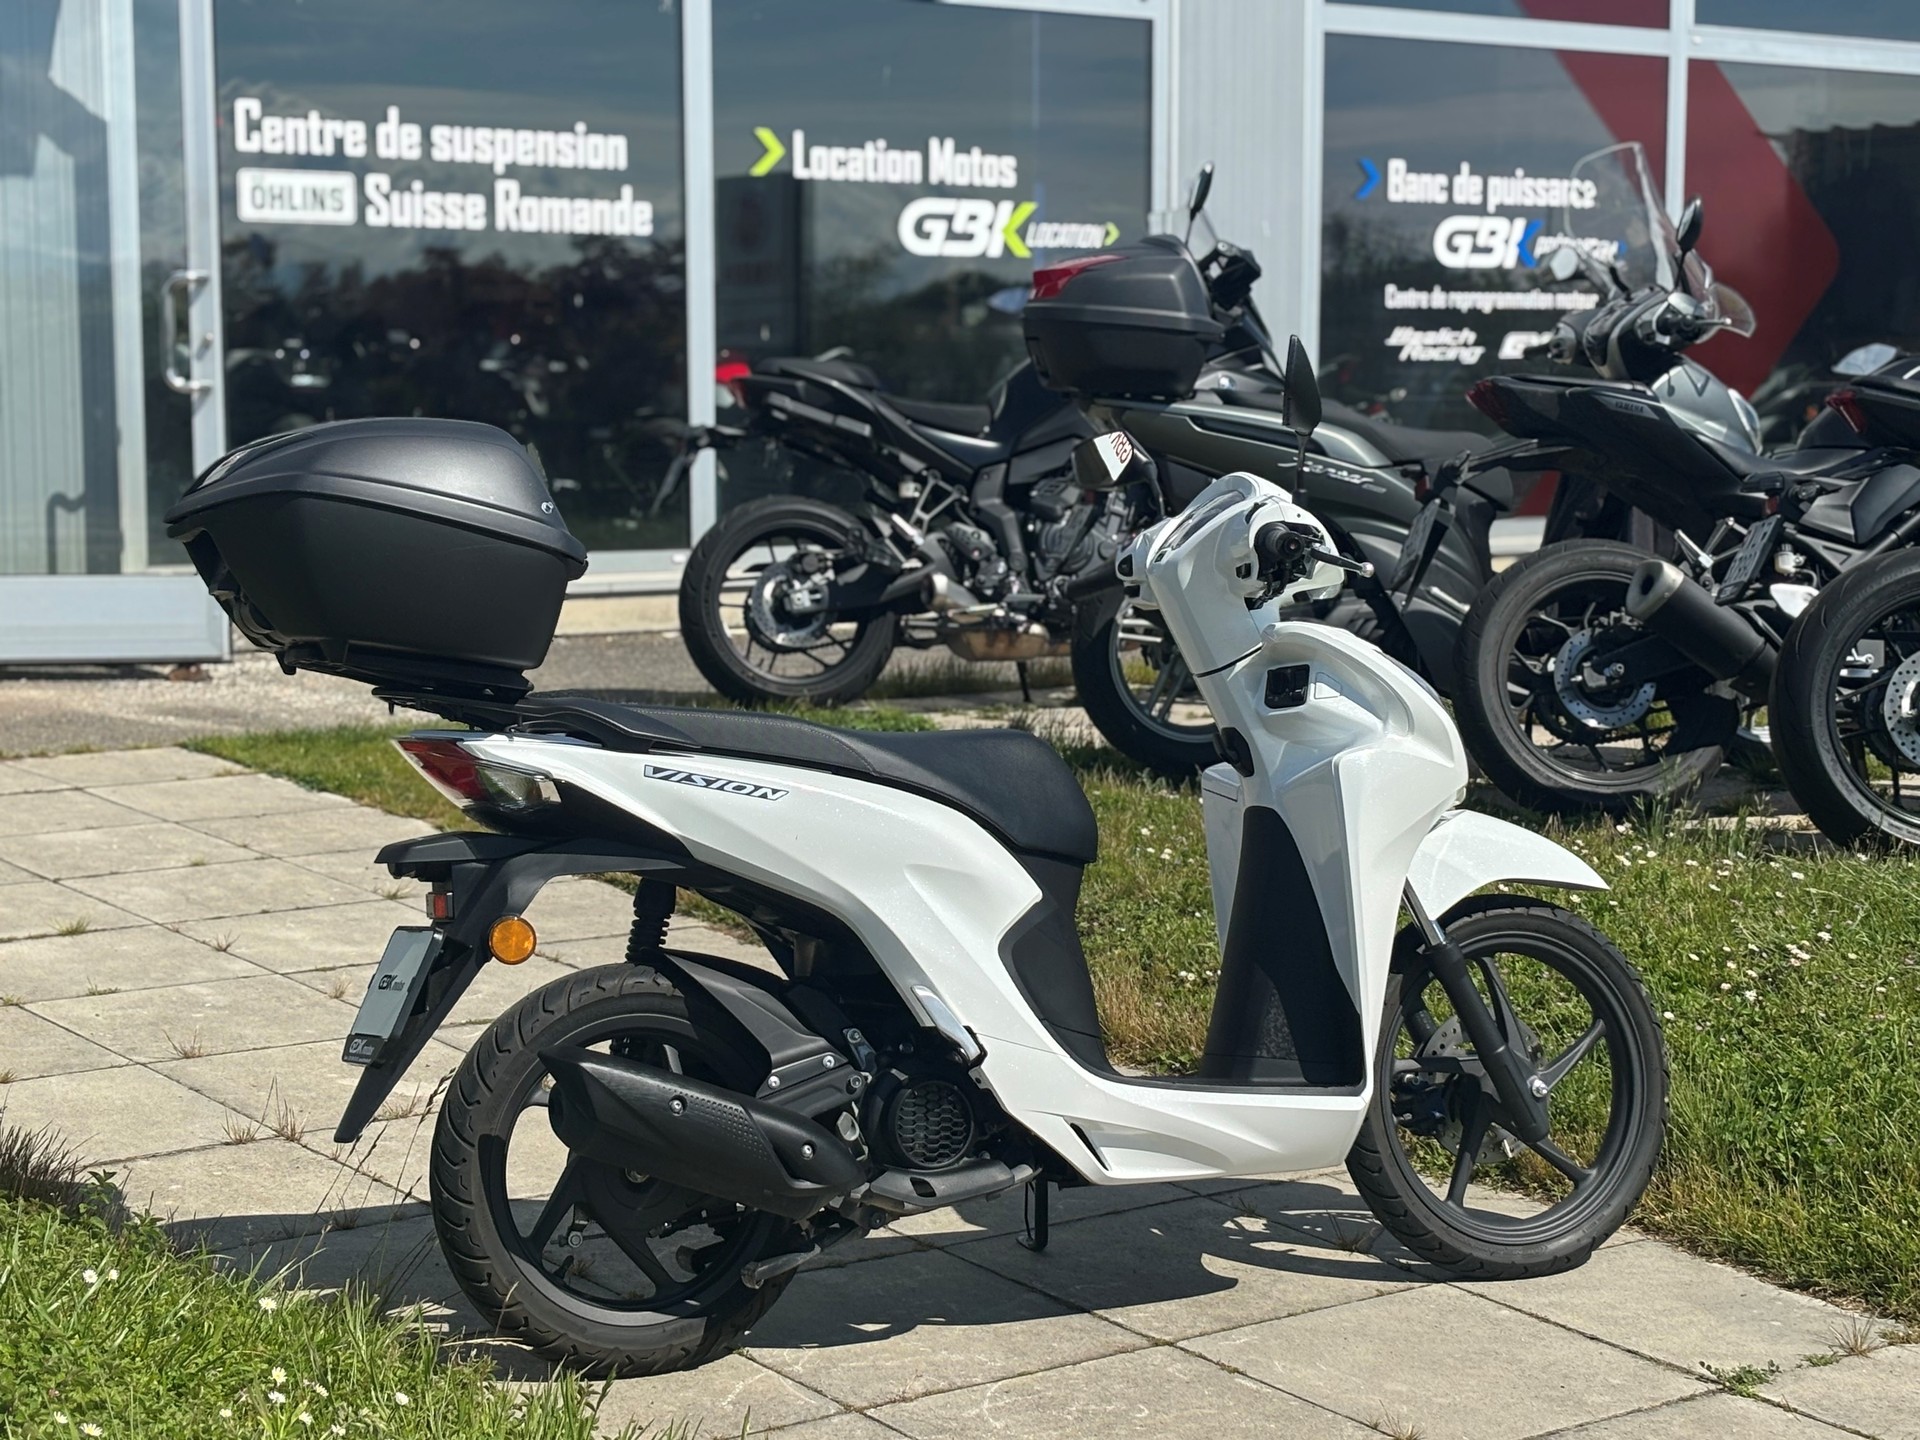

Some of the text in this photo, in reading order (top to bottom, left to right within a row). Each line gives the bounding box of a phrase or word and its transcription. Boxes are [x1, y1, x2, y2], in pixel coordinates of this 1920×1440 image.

[233, 97, 629, 175] Centre de suspension
[792, 129, 1018, 188] Location Motos
[251, 172, 653, 237] ÖHLINS Suisse Romande
[1387, 158, 1448, 203] Banc
[1452, 161, 1483, 205] de
[897, 196, 1106, 258] GBK LOCATION
[1433, 215, 1545, 269] GBK
[1384, 283, 1430, 309] Centre
[644, 765, 789, 800] VISION
